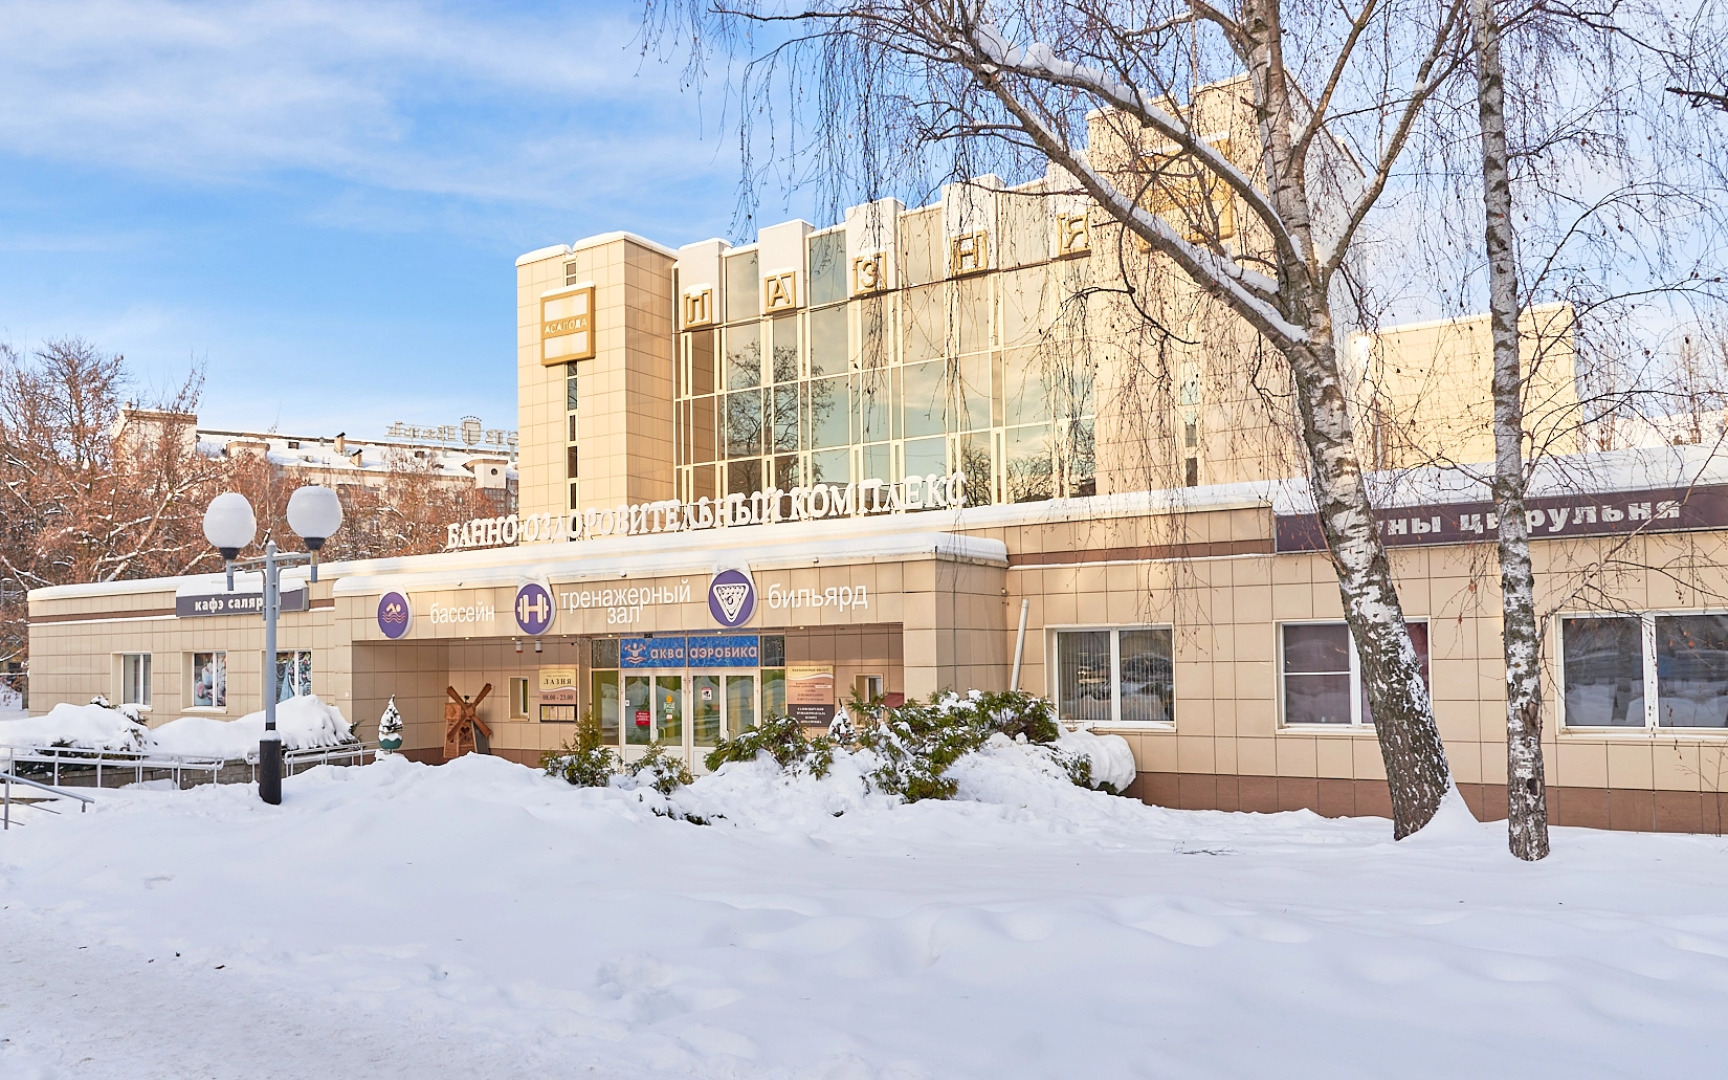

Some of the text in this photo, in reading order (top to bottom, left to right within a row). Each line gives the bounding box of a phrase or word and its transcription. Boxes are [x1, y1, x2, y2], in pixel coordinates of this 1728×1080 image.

[788, 471, 968, 522] КОМПЛЕКС
[194, 595, 282, 613] кафэ саляр
[559, 578, 691, 615] тренажерный
[768, 583, 869, 613] бильярд
[430, 601, 496, 625] бассейн
[607, 605, 640, 625] зал
